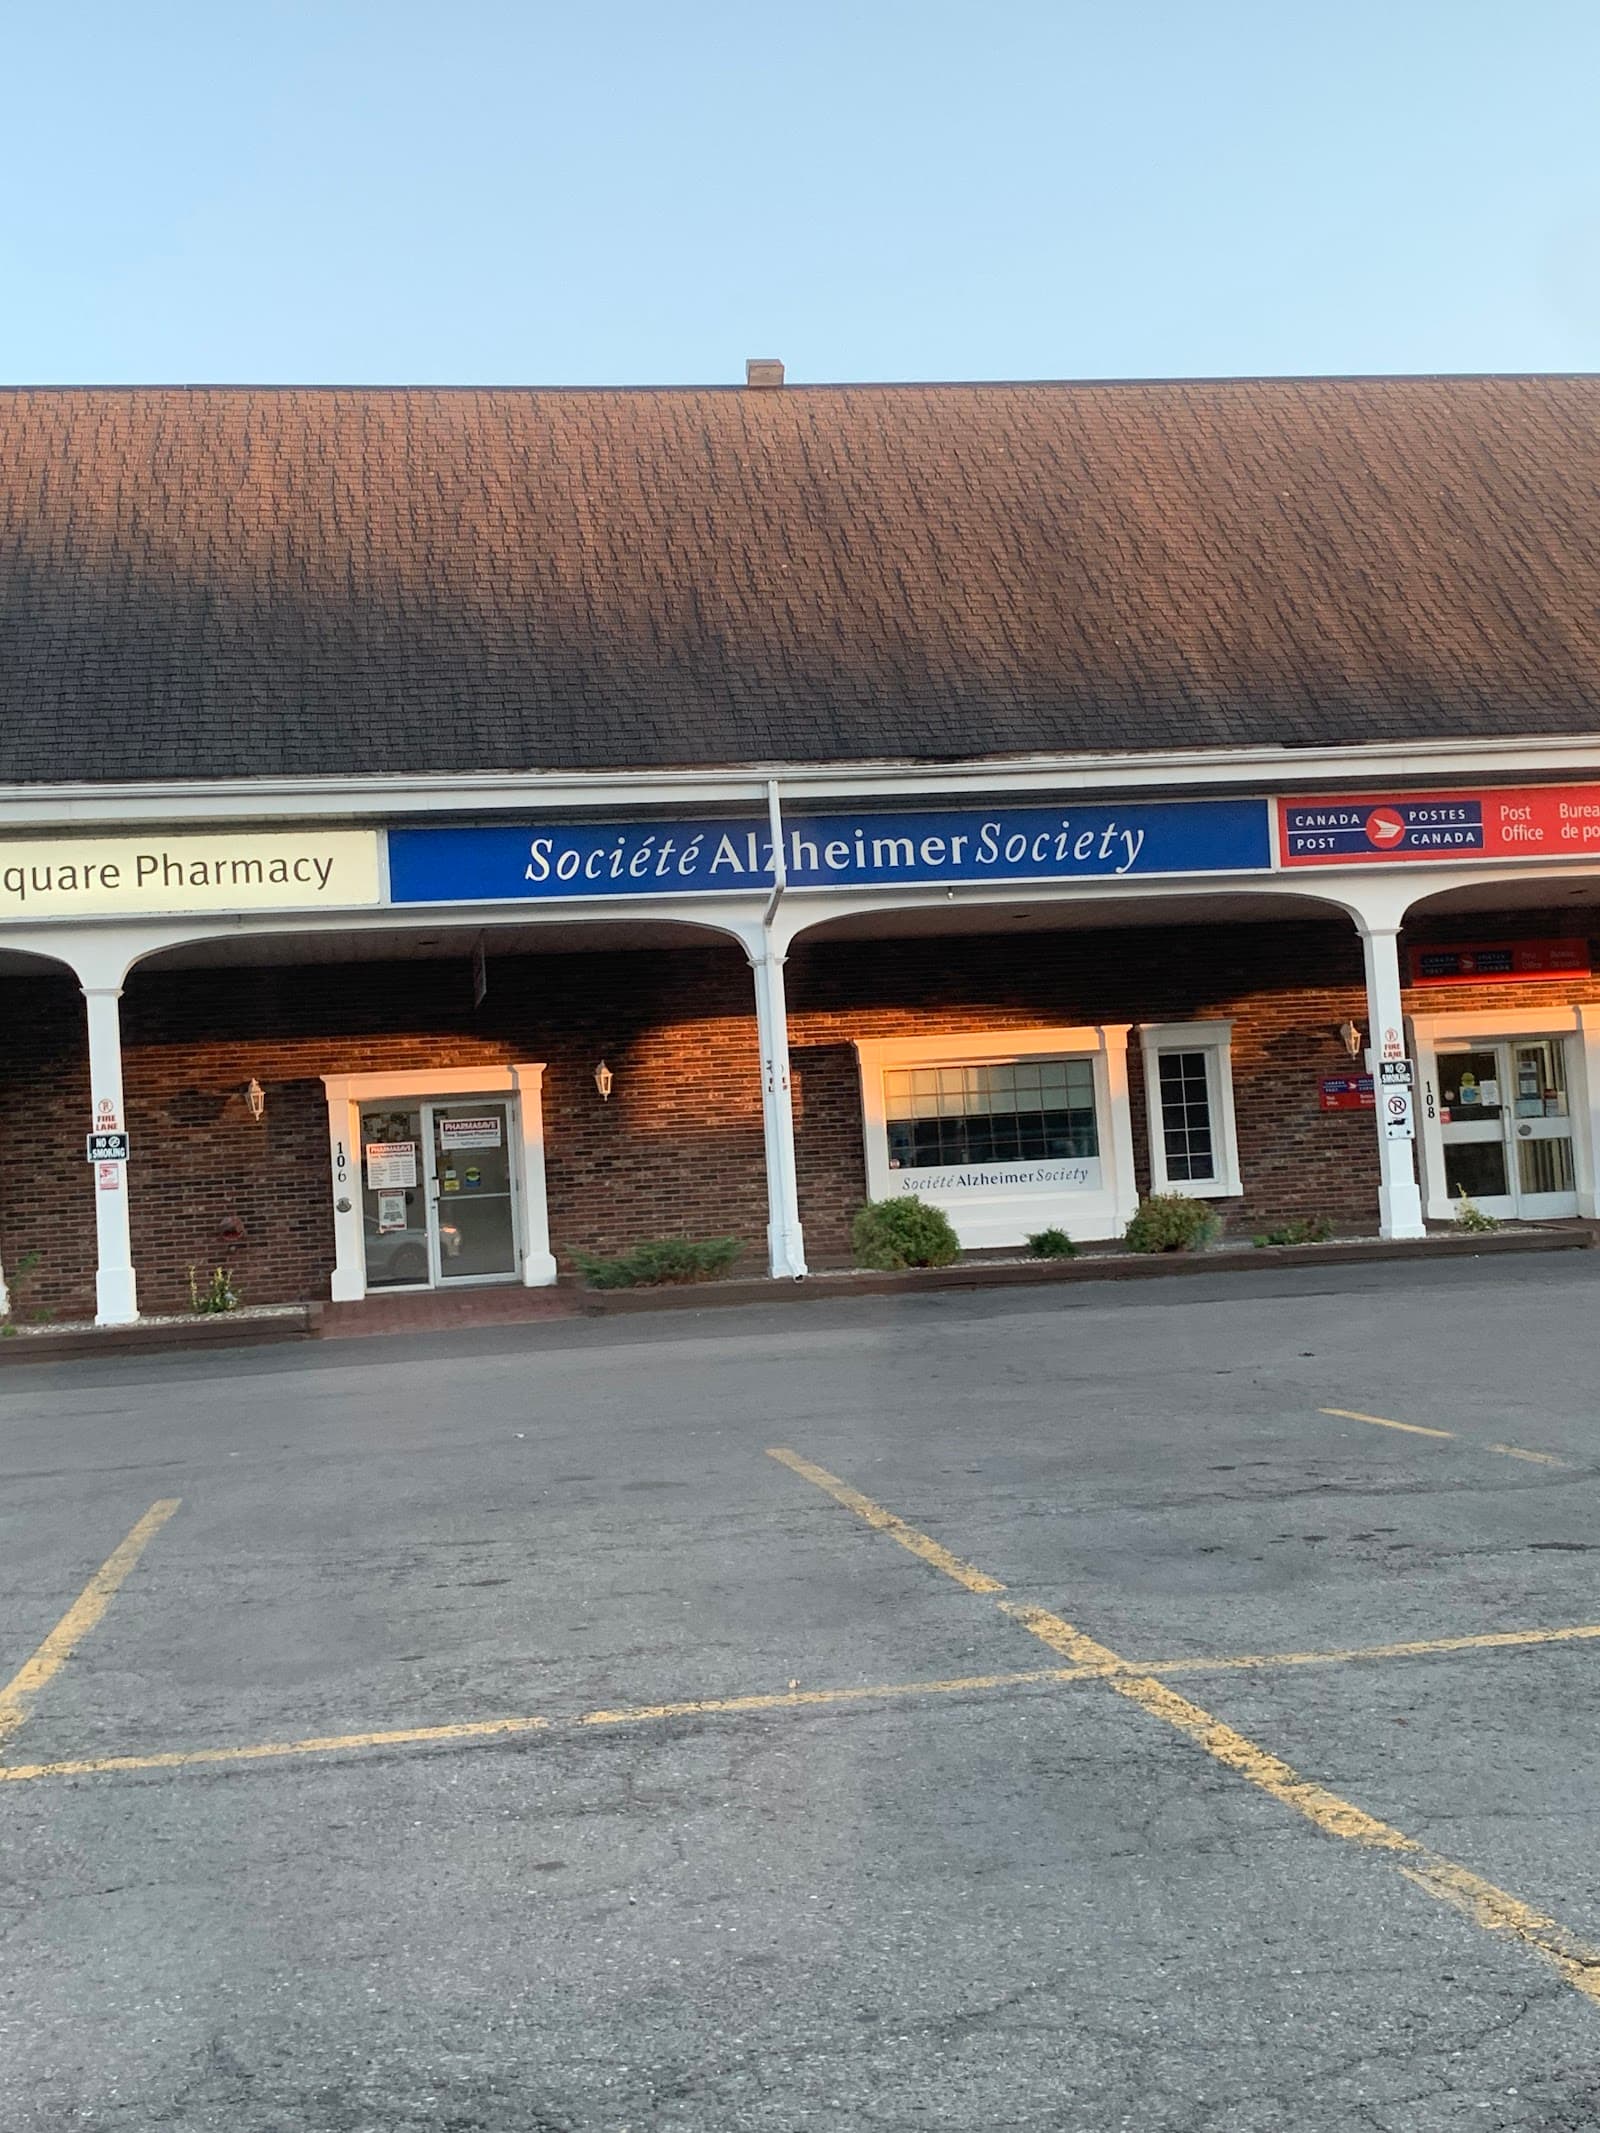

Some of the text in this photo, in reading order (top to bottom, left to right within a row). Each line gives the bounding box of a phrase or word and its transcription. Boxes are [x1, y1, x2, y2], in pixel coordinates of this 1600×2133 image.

[1408, 809, 1466, 822] POSTES
[1500, 805, 1532, 821] Post
[1295, 813, 1361, 827] CANADA
[1501, 823, 1544, 842] Office
[1561, 823, 1579, 839] de
[1297, 837, 1336, 850] POST
[1410, 832, 1476, 846] CANADA
[524, 820, 1145, 881] Société Alzheimer Society
[3, 852, 333, 900] quare Pharmacy
[1384, 1043, 1401, 1051] FIRE
[1383, 1050, 1402, 1059] LANE
[1384, 1064, 1394, 1074] NO
[1382, 1074, 1411, 1084] SMOKING
[1425, 1081, 1436, 1119] 108
[97, 1114, 116, 1123] FIRE
[96, 1123, 118, 1131] LANE
[444, 1121, 497, 1131] PHARMASAVE
[95, 1137, 107, 1148] NO
[92, 1147, 126, 1159] SMOKING
[336, 1141, 347, 1183] 106
[903, 1167, 1089, 1191] Société Alzheimer Society
